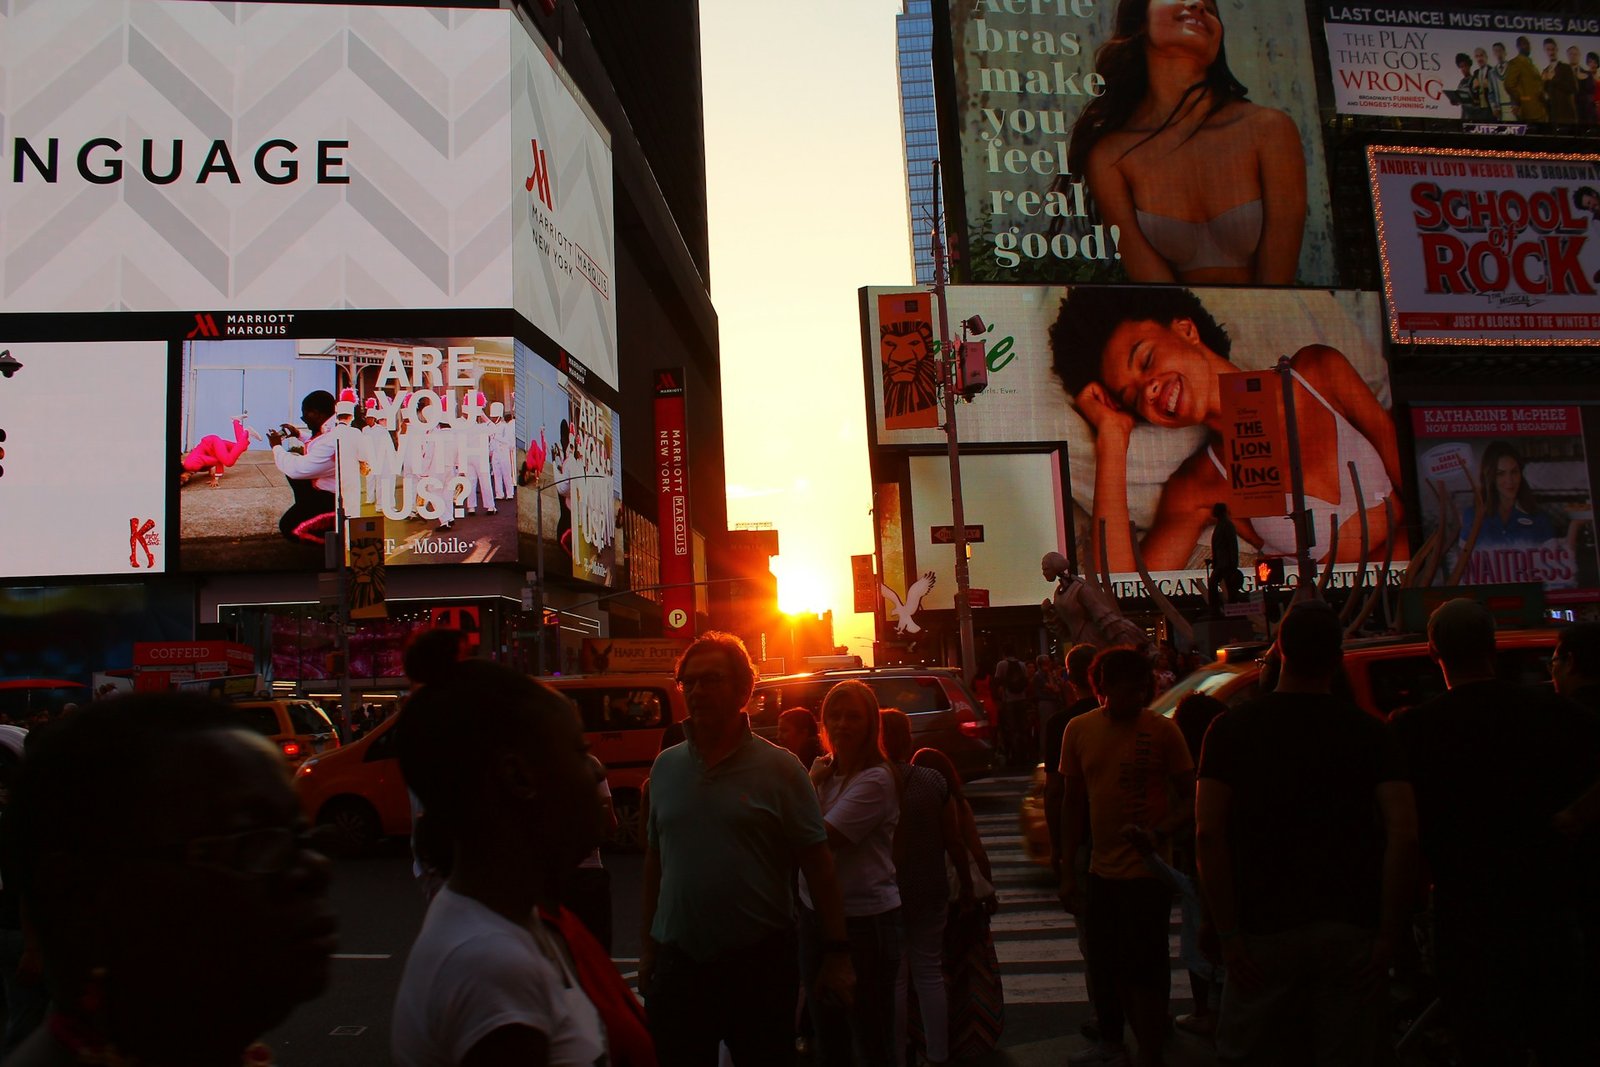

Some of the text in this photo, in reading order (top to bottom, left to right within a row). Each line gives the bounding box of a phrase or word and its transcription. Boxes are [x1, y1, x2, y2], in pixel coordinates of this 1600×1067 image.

[1329, 6, 1599, 33] LAST CHANCE! MUST CLOTHES AUG
[974, 18, 1080, 56] bras
[1343, 31, 1428, 50] THE PLAY
[1337, 50, 1442, 72] THAT GOES
[978, 62, 1106, 97] make
[1339, 69, 1444, 101] WRONG
[981, 108, 1068, 141] you
[13, 137, 350, 184] NGUAGE
[985, 139, 1072, 175] feel
[1380, 161, 1427, 176] ANDREW
[1430, 162, 1466, 177] LLOYD
[1469, 163, 1514, 178] WEBBER
[1517, 165, 1539, 179] HAS
[988, 183, 1088, 217] real
[1410, 181, 1589, 233] SCHOOL
[532, 203, 607, 293] MARRIOTT MARQUIS
[532, 228, 574, 280] NEW YORK
[994, 224, 1121, 268] good!
[1487, 222, 1517, 256] of
[1417, 232, 1598, 295] ROCK
[227, 314, 295, 324] MARRIOTT
[227, 325, 288, 335] MARQUIS
[1454, 315, 1476, 328] JUST
[1478, 315, 1485, 328] 4
[1487, 315, 1521, 328] BLOCKS
[1523, 315, 1535, 328] TO
[1536, 315, 1553, 328] THE
[375, 346, 475, 387] ARE
[374, 389, 477, 430] YOU
[1424, 408, 1567, 423] KATHARINE McPHEE
[1233, 421, 1264, 436] THE
[1426, 422, 1567, 433] NOW STARRING ON BROADWAY
[367, 431, 489, 475] WITH
[660, 431, 670, 493] NEW YORK
[1230, 440, 1272, 461] LION
[672, 430, 686, 554] MARRIOTT MARQUIS
[1230, 464, 1281, 489] KING
[383, 476, 471, 521] US?
[674, 612, 683, 625] P
[149, 648, 210, 659] COFFEED
[614, 647, 646, 658] HARRY
